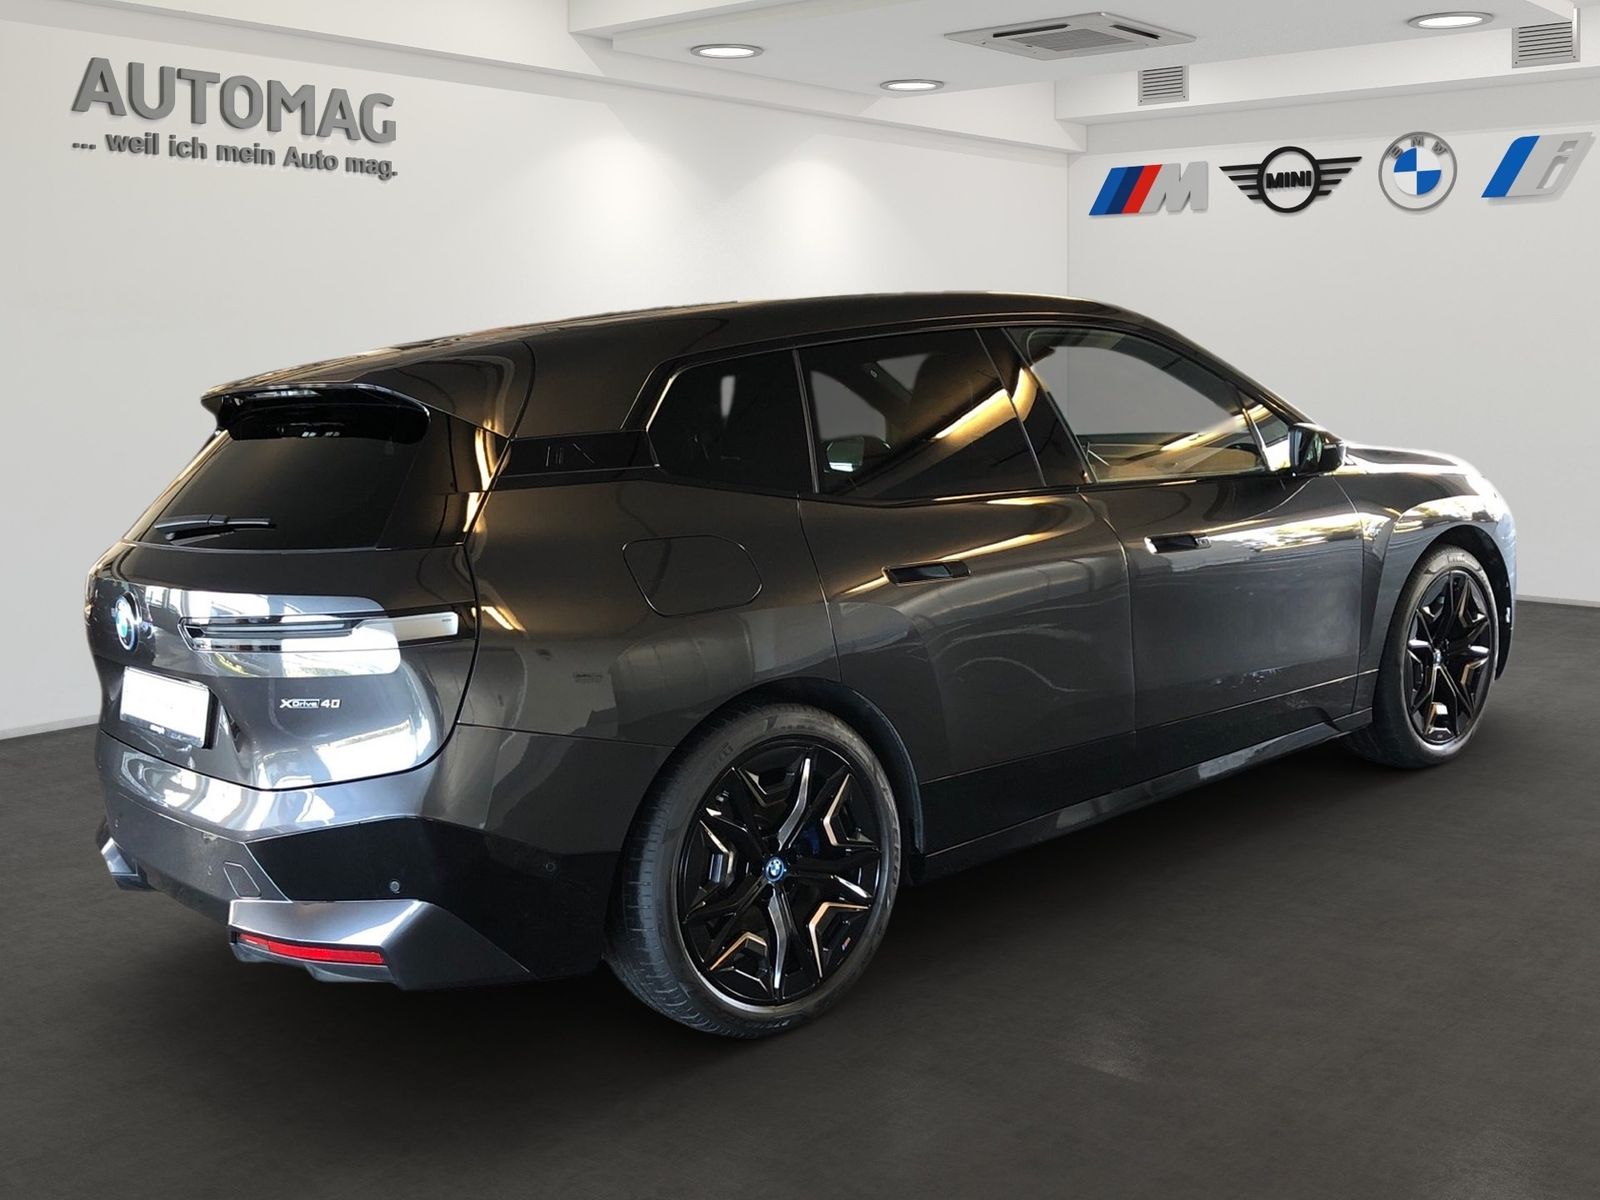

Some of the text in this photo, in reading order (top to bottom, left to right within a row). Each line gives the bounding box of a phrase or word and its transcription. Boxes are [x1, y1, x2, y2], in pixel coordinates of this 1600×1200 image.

[72, 57, 397, 144] AUTOMAG
[105, 132, 159, 155] weil
[169, 134, 208, 159] ich
[216, 143, 275, 165] mein
[283, 146, 338, 170] Auto
[345, 157, 398, 180] mag.
[1387, 135, 1448, 159] BMW
[1266, 171, 1312, 190] MINI
